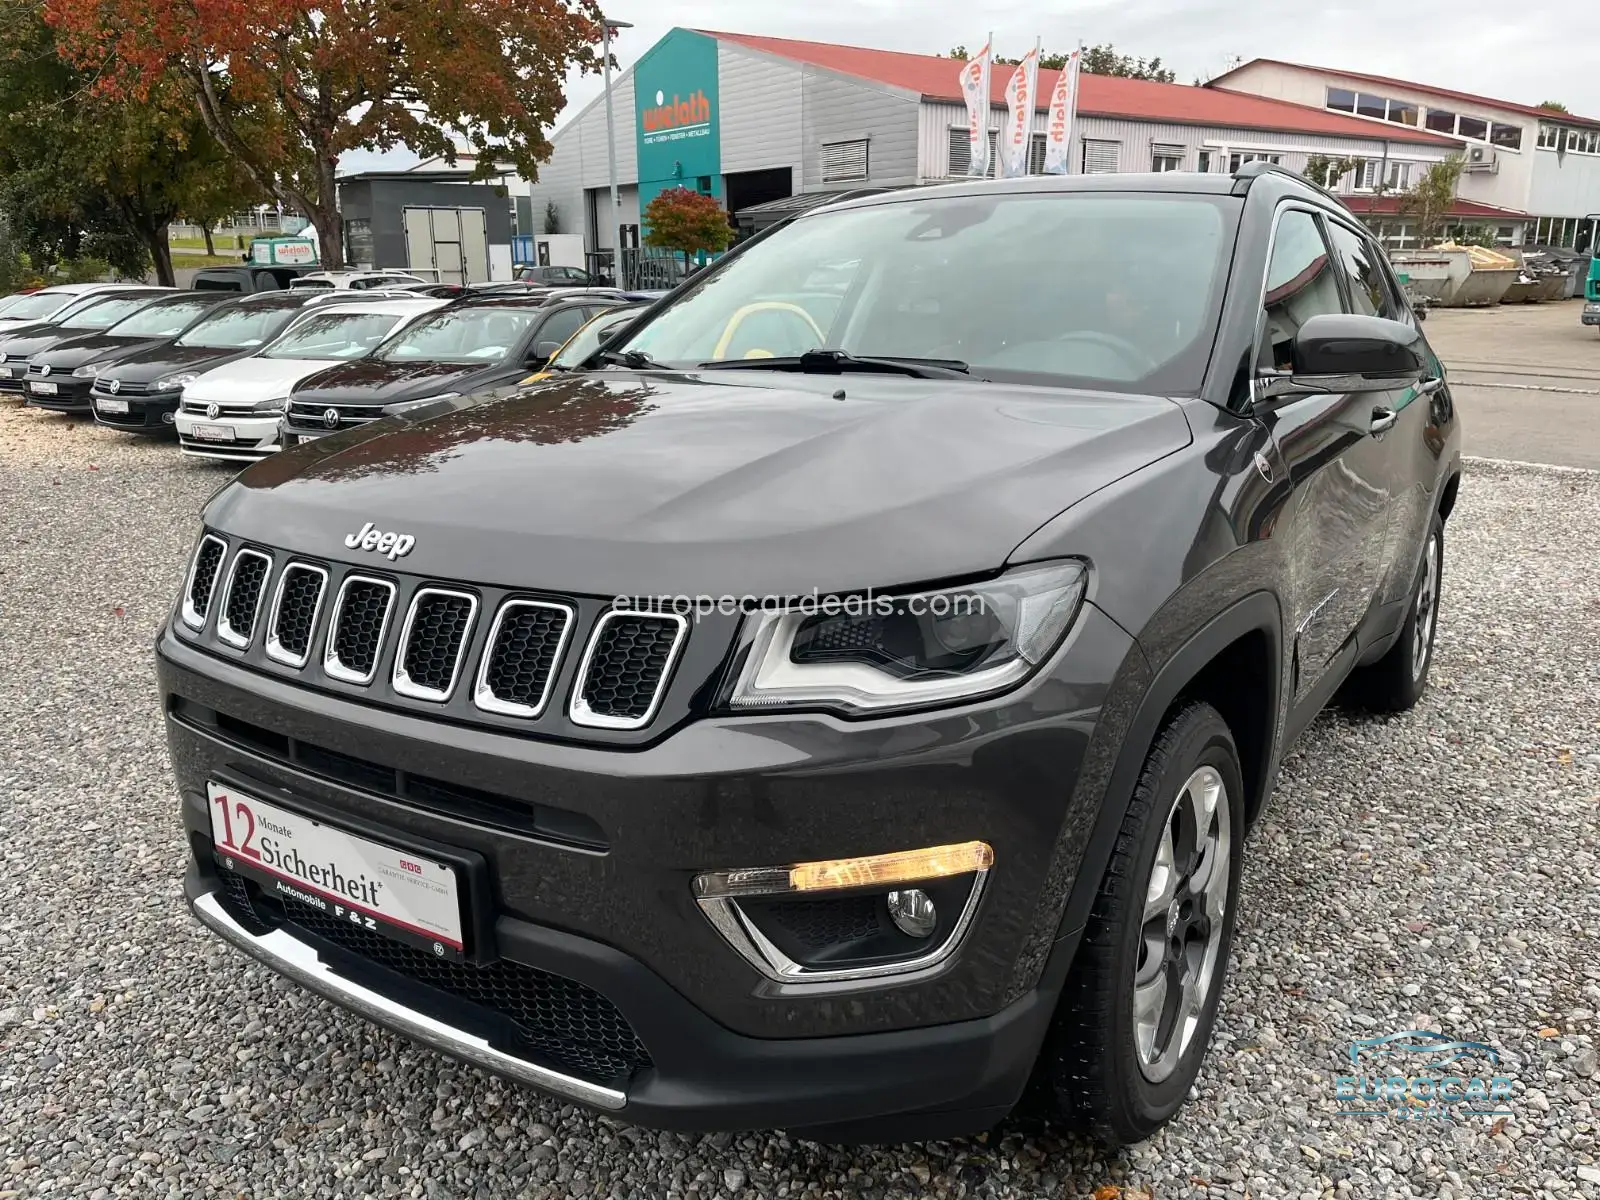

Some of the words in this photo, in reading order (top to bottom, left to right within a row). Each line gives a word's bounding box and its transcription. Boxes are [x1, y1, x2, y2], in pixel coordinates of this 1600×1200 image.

[643, 89, 709, 131] wieloth
[344, 522, 416, 562] Jeep
[214, 795, 261, 862] 12
[257, 814, 292, 838] Monate
[276, 880, 326, 910] Automobile
